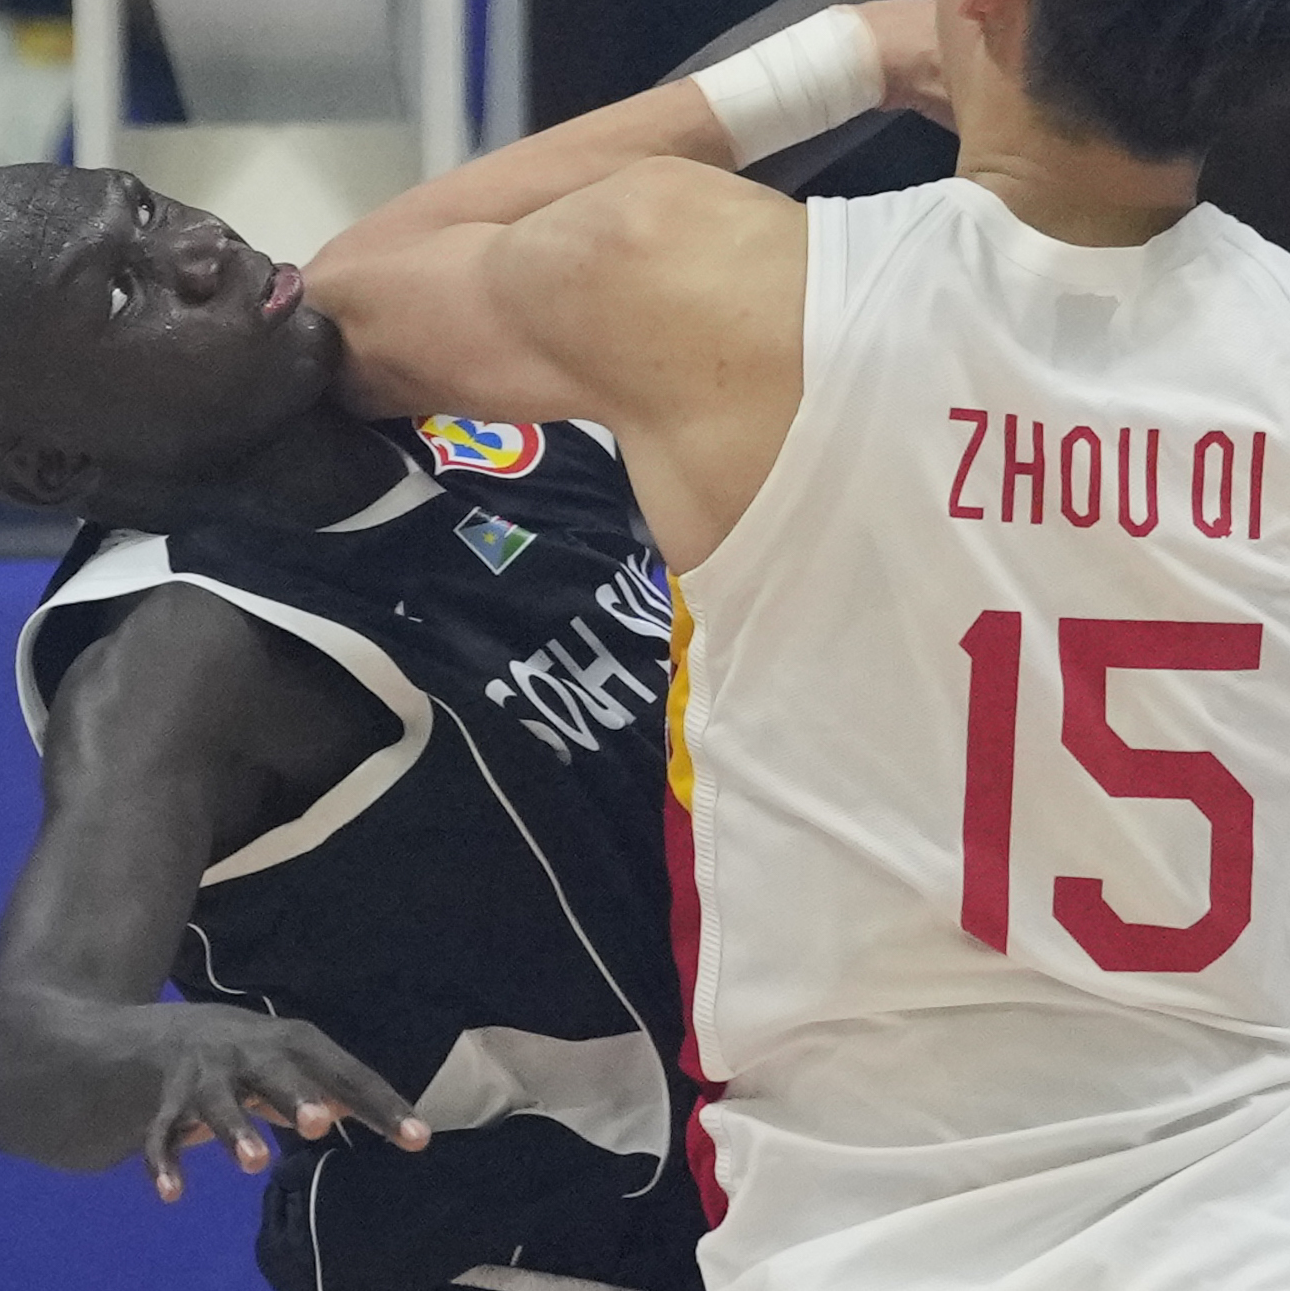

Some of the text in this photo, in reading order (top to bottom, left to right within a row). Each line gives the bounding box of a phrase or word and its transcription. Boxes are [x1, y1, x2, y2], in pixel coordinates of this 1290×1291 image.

[949, 407, 1267, 540] ZHOU QI
[958, 609, 1264, 973] 15
